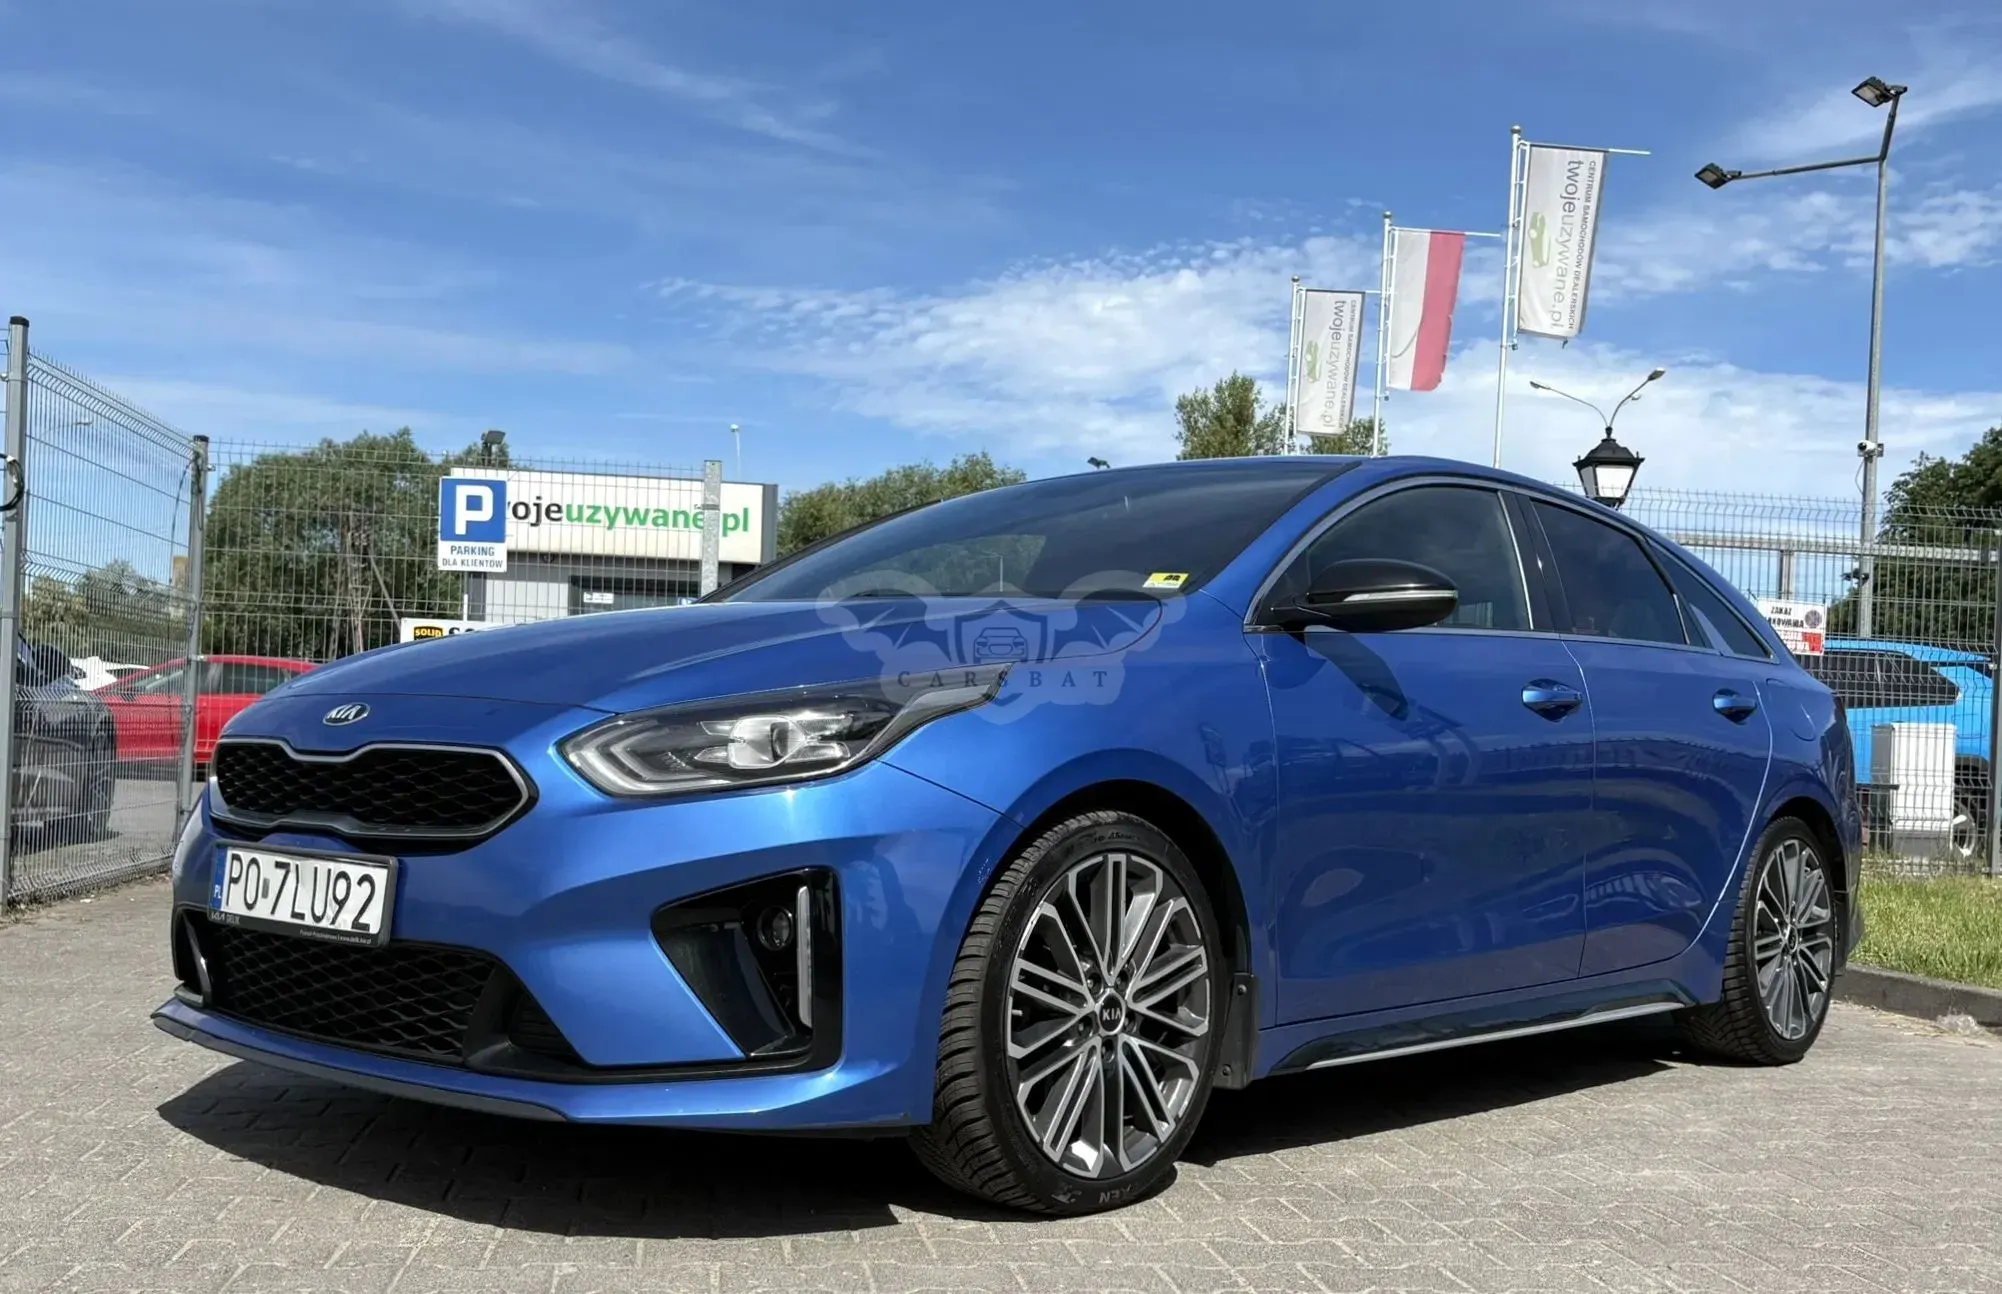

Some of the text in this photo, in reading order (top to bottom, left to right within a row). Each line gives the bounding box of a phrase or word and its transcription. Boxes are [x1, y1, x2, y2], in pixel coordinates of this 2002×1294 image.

[1584, 160, 1597, 203] CENTRUM
[1551, 160, 1584, 328] twojeuzywane.pl
[1568, 271, 1583, 330] DEALERSKICH
[1320, 300, 1347, 428] twojeuzywane.pl
[455, 484, 494, 535] P
[507, 496, 749, 538] ojeuzywanepl
[442, 558, 458, 567] DLA
[450, 545, 495, 557] PARKING
[415, 627, 442, 638] SOLID
[327, 705, 361, 720] KIA
[214, 884, 222, 899] PL
[226, 852, 376, 932] PO 7LU92
[1102, 1007, 1121, 1021] KIA
